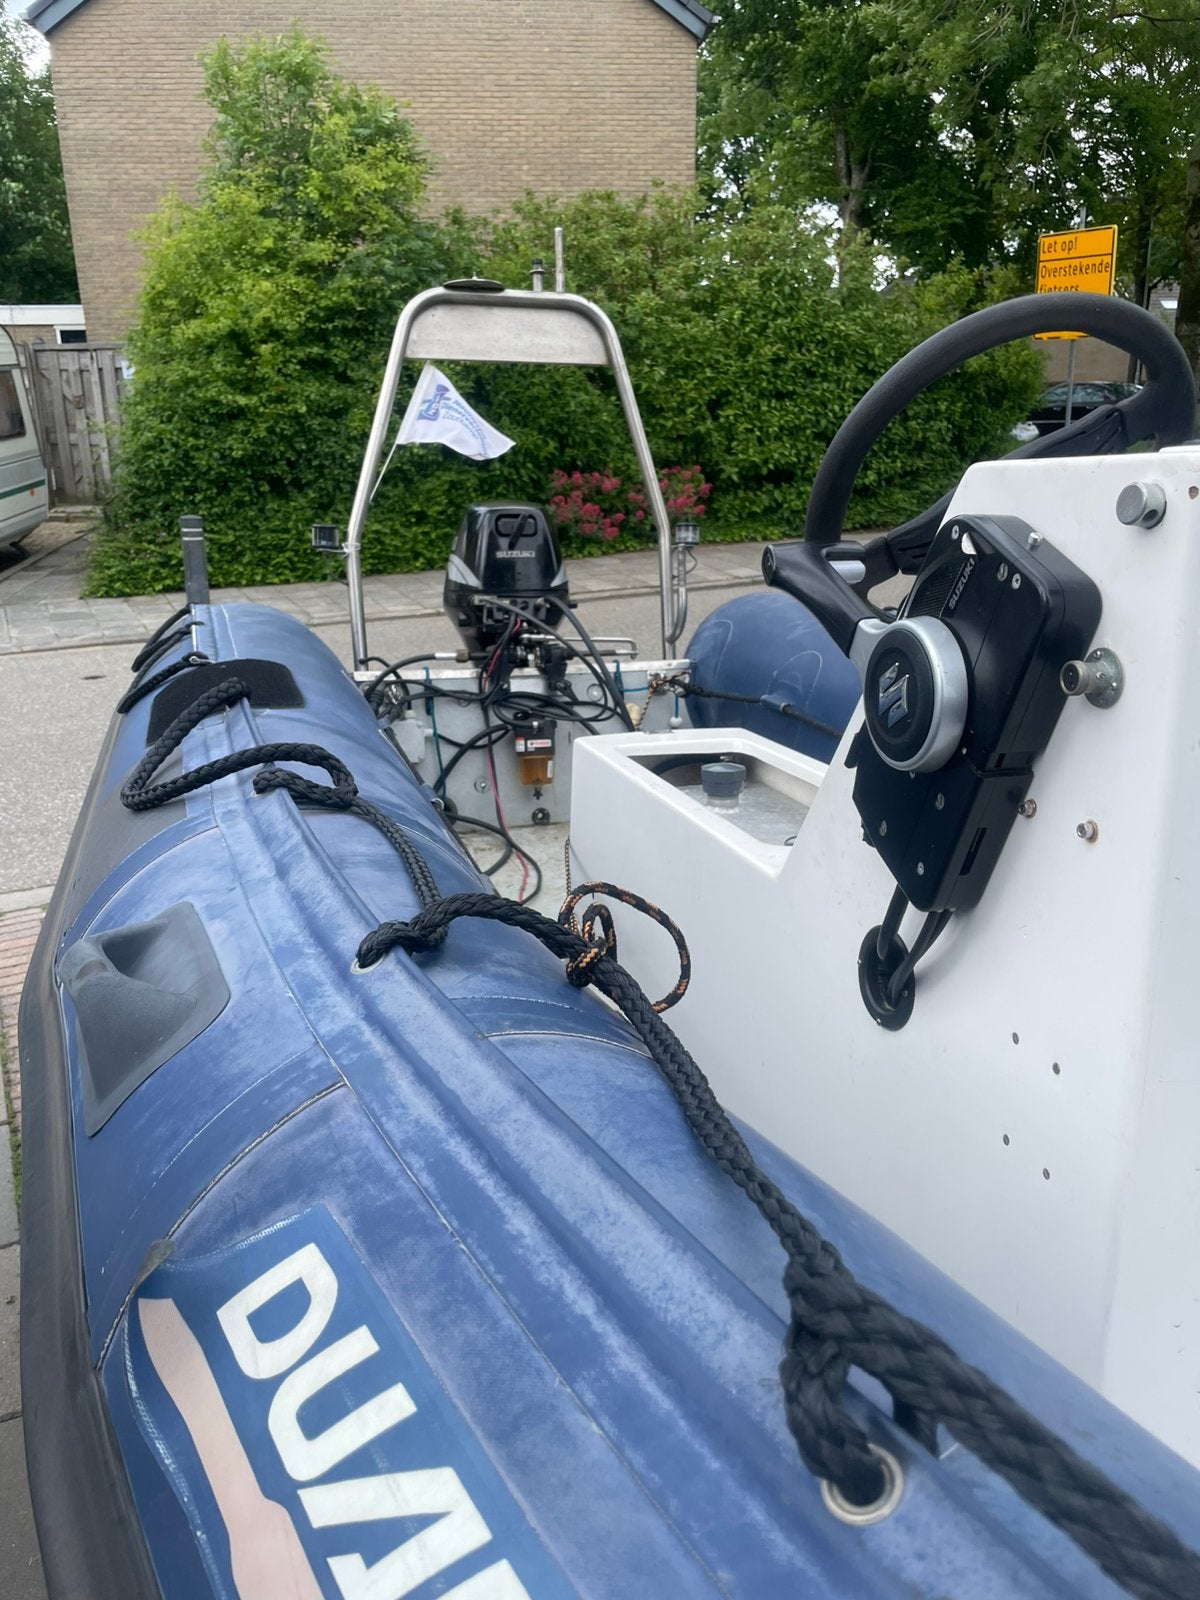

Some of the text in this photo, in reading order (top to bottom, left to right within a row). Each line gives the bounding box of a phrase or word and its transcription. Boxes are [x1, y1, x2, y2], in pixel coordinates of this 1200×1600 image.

[1042, 236, 1078, 255] Let op!
[1040, 259, 1110, 279] Overstekende
[495, 550, 535, 559] SUZUKI
[949, 557, 975, 610] SUZUKI
[216, 1242, 531, 1600] DUA
